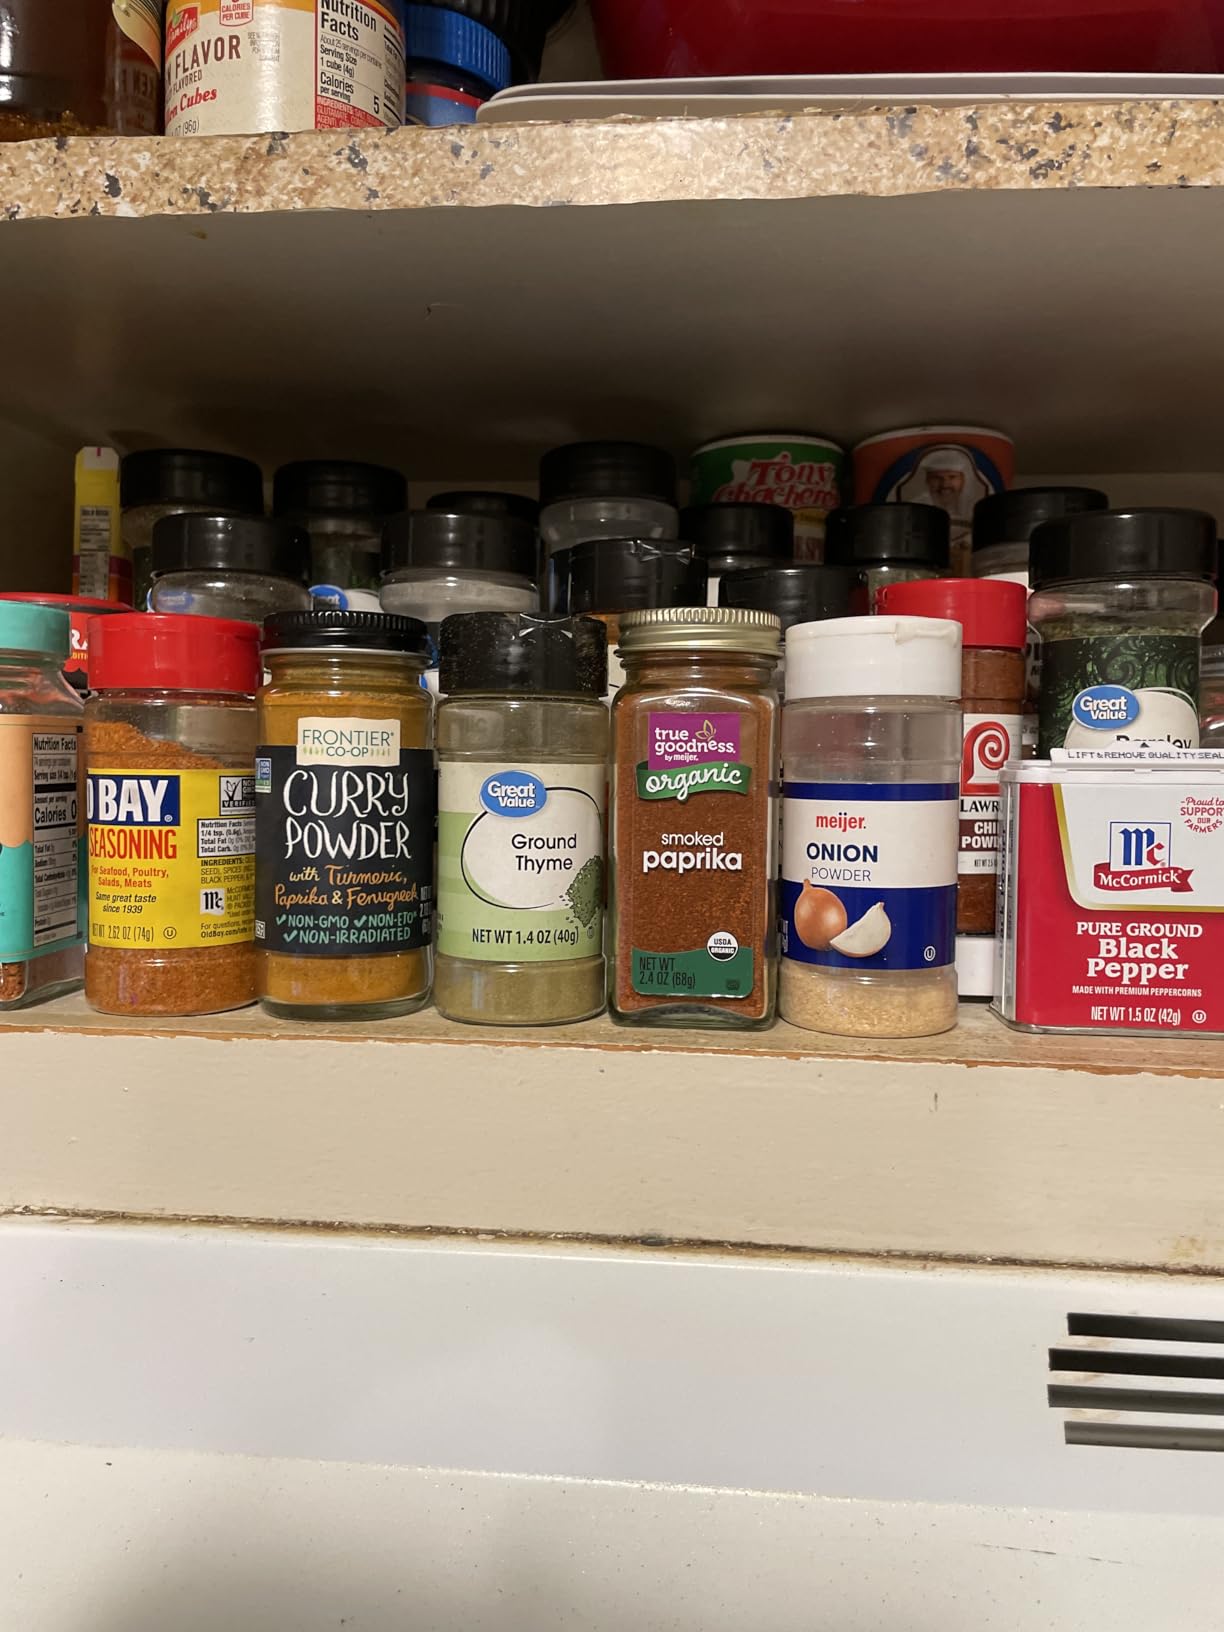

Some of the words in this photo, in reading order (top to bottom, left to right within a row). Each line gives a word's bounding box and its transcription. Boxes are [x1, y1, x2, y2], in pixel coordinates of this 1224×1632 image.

[222, 2, 251, 13] CALORIES
[320, 0, 377, 32] Nutrition
[222, 12, 233, 21] PER
[320, 11, 360, 41] Facts
[175, 34, 241, 79] FLAVOR
[320, 44, 344, 62] Serving
[345, 52, 357, 66] Size
[180, 86, 218, 112] Cubes
[320, 71, 354, 94] Calories
[373, 95, 380, 115] 5
[320, 86, 330, 95] per
[331, 89, 351, 104] serving
[182, 119, 200, 136] (96g)
[1079, 696, 1127, 711] Great
[1091, 709, 1127, 721] Value
[303, 729, 391, 747] FRONTIER
[654, 727, 690, 741] true
[34, 737, 60, 750] Nutrition
[61, 737, 77, 750] Facts
[326, 746, 369, 757] CO-OP
[664, 754, 673, 762] by
[1067, 751, 1095, 759] LIFT
[1104, 751, 1146, 759] REMOVE
[1148, 751, 1197, 759] QUALITY
[1197, 751, 1224, 759] SEAL
[487, 780, 536, 798] Great
[645, 762, 743, 801] organic
[98, 778, 169, 823] BAY
[283, 769, 409, 818] CURRY
[498, 796, 536, 808] Value
[1185, 796, 1214, 806] Proud
[34, 806, 67, 824] Calories
[71, 799, 77, 819] 0
[960, 799, 999, 813] LAWR
[200, 829, 212, 838] 1/4
[974, 821, 998, 835] CHI
[1183, 818, 1223, 834] FARMERS
[89, 828, 178, 860] SEASONING
[200, 838, 216, 846] Total
[217, 837, 227, 845] Fat
[284, 816, 412, 860] POWDER
[511, 833, 577, 850] Ground
[660, 831, 724, 847] smoked
[200, 846, 216, 854] Total
[806, 842, 879, 863] ONION
[200, 857, 244, 867] INGREDIENTS:
[515, 855, 573, 874] Thyme
[642, 847, 743, 874] paprika
[99, 865, 131, 878] Seafood,
[132, 867, 169, 879] Poultry,
[200, 876, 222, 885] BLACK
[289, 866, 321, 883] with
[324, 864, 408, 887] Turmeric,
[810, 866, 872, 882] POWDER
[1098, 869, 1182, 887] McCormick
[97, 877, 122, 888] Salads,
[124, 879, 152, 888] Meats
[95, 891, 111, 901] Same
[111, 893, 133, 903] great
[134, 894, 157, 903] taste
[274, 883, 329, 910] Paprika
[331, 890, 343, 905] &
[346, 882, 418, 911] Fenugreek
[102, 903, 121, 913] since
[122, 904, 143, 914] 1939
[287, 914, 349, 929] NON-GMO
[1076, 921, 1122, 936] PURE
[1126, 923, 1203, 938] GROUND
[122, 926, 132, 940] OZ
[133, 925, 154, 943] (74g)
[299, 926, 411, 944] NON-IRRADIATED
[472, 928, 492, 944] NET
[494, 929, 512, 944] WT
[516, 930, 534, 944] 1.4
[536, 930, 551, 944] OZ
[553, 926, 579, 946] (40g)
[713, 938, 732, 946] USDA
[1098, 937, 1179, 959] Black
[639, 956, 657, 971] NET
[658, 957, 676, 972] WT
[1086, 958, 1189, 985] Pepper
[639, 970, 654, 985] 2.4
[656, 971, 670, 986] OZ
[672, 972, 696, 989] (68g)
[1072, 985, 1094, 994] MADE
[1094, 986, 1114, 995] WITH
[1115, 986, 1149, 996] PREMIUM
[1150, 988, 1202, 997] PEPPERCORNS
[1090, 1006, 1108, 1021] NET
[1109, 1006, 1126, 1021] WT
[1128, 1007, 1142, 1022] 1.5
[1143, 1008, 1156, 1022] OZ
[1158, 1007, 1181, 1026] (42g)
